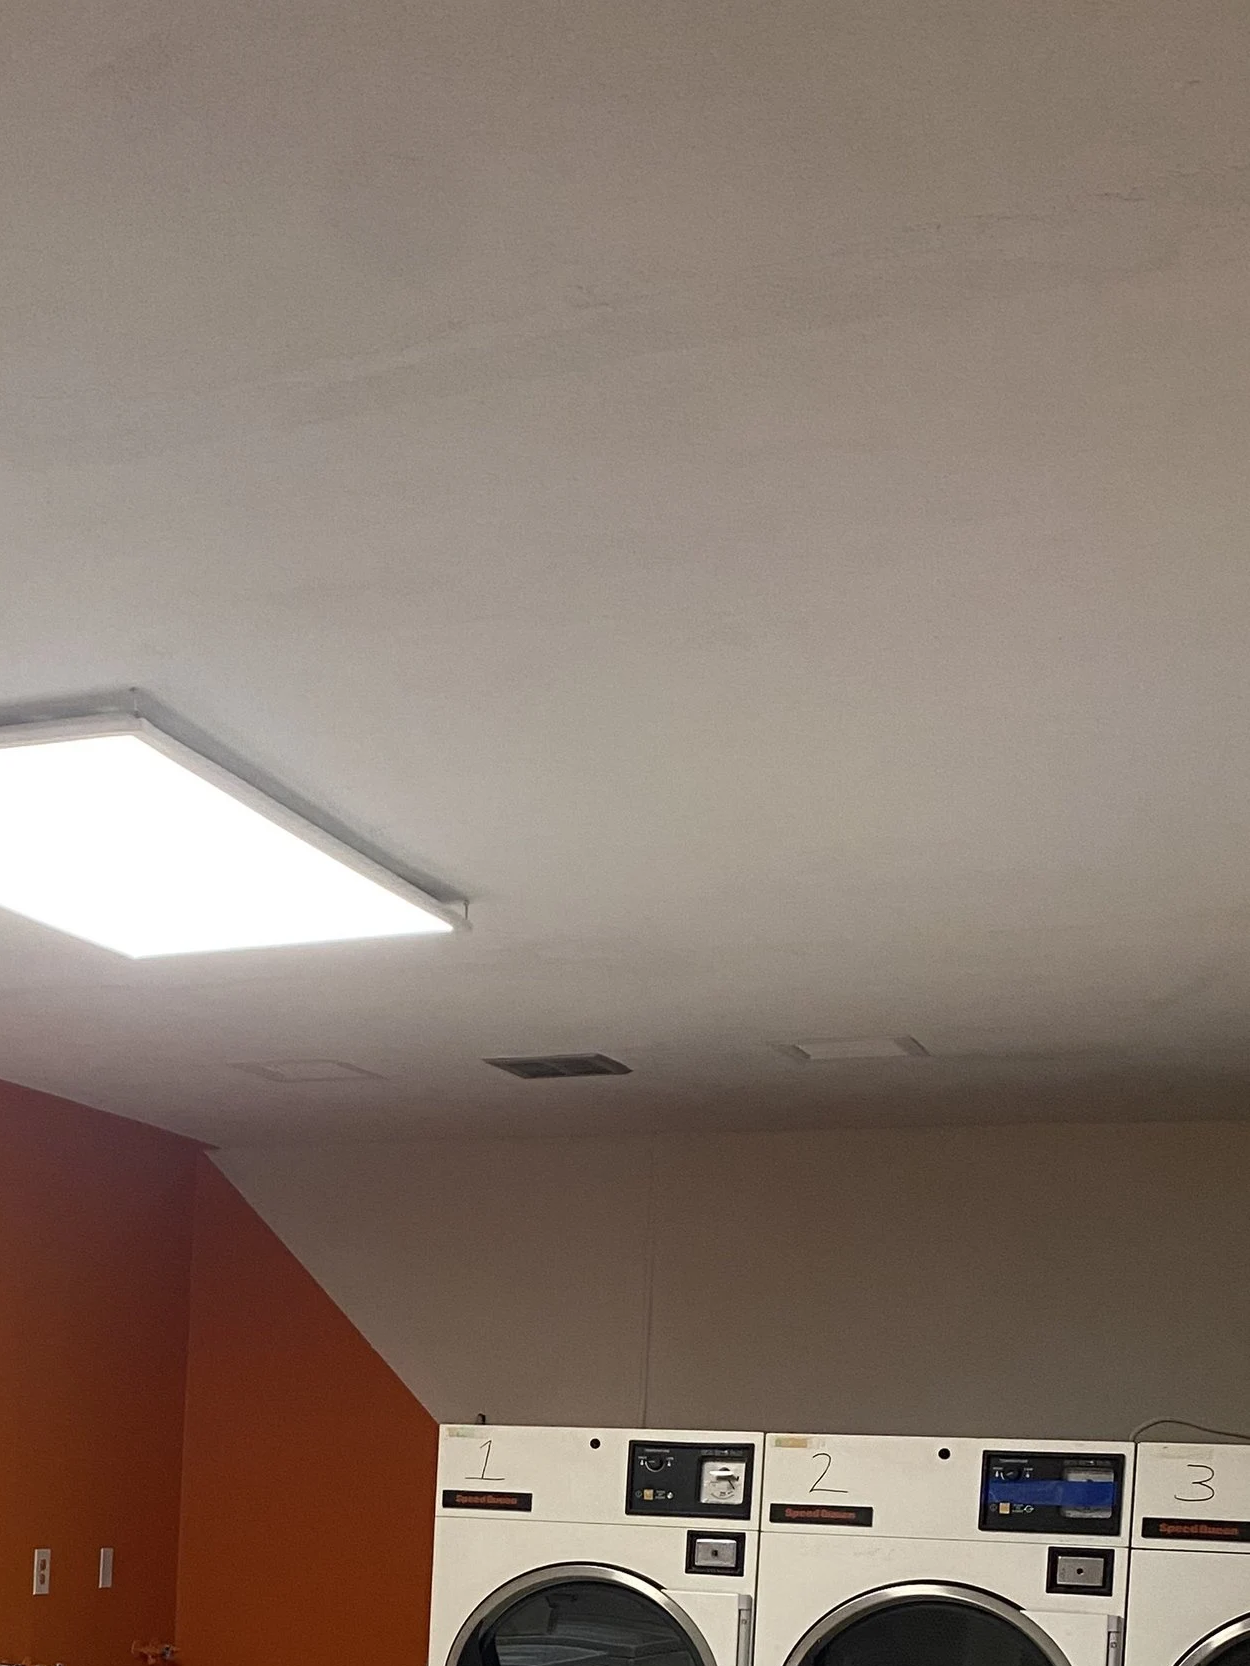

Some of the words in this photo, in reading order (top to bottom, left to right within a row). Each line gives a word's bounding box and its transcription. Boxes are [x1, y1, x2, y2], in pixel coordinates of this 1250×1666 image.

[465, 1439, 506, 1481] 1
[809, 1452, 849, 1493] 2
[1174, 1464, 1215, 1502] 3
[784, 1507, 820, 1519] Speed
[1158, 1522, 1199, 1534] Speed
